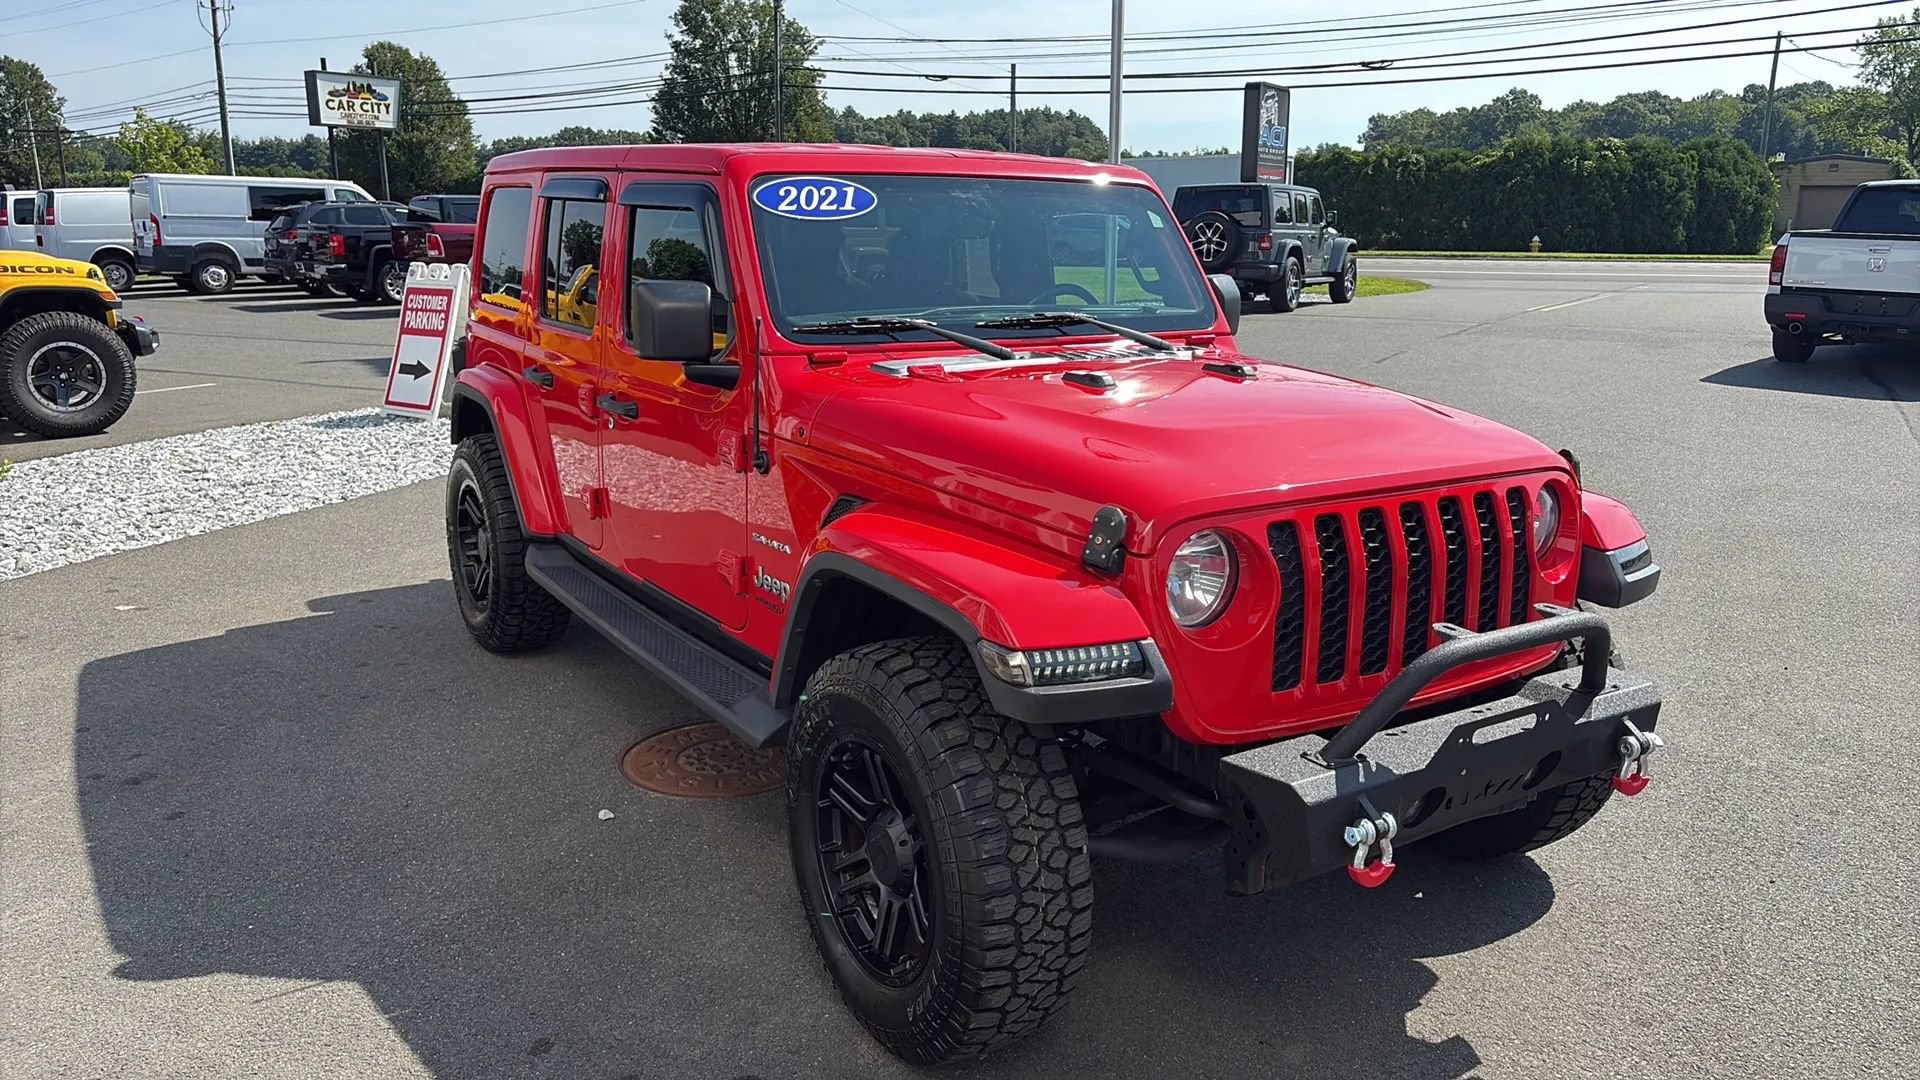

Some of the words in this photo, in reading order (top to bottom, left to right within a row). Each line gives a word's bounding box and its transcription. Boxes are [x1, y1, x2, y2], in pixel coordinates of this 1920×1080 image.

[325, 99, 355, 112] CAR
[360, 101, 391, 115] CITY
[1259, 124, 1286, 147] ACI
[778, 186, 856, 211] 2021
[407, 294, 448, 311] CUSTOMER
[404, 311, 445, 331] PARKING
[752, 532, 791, 554] SAHARA
[753, 565, 790, 604] Jeep
